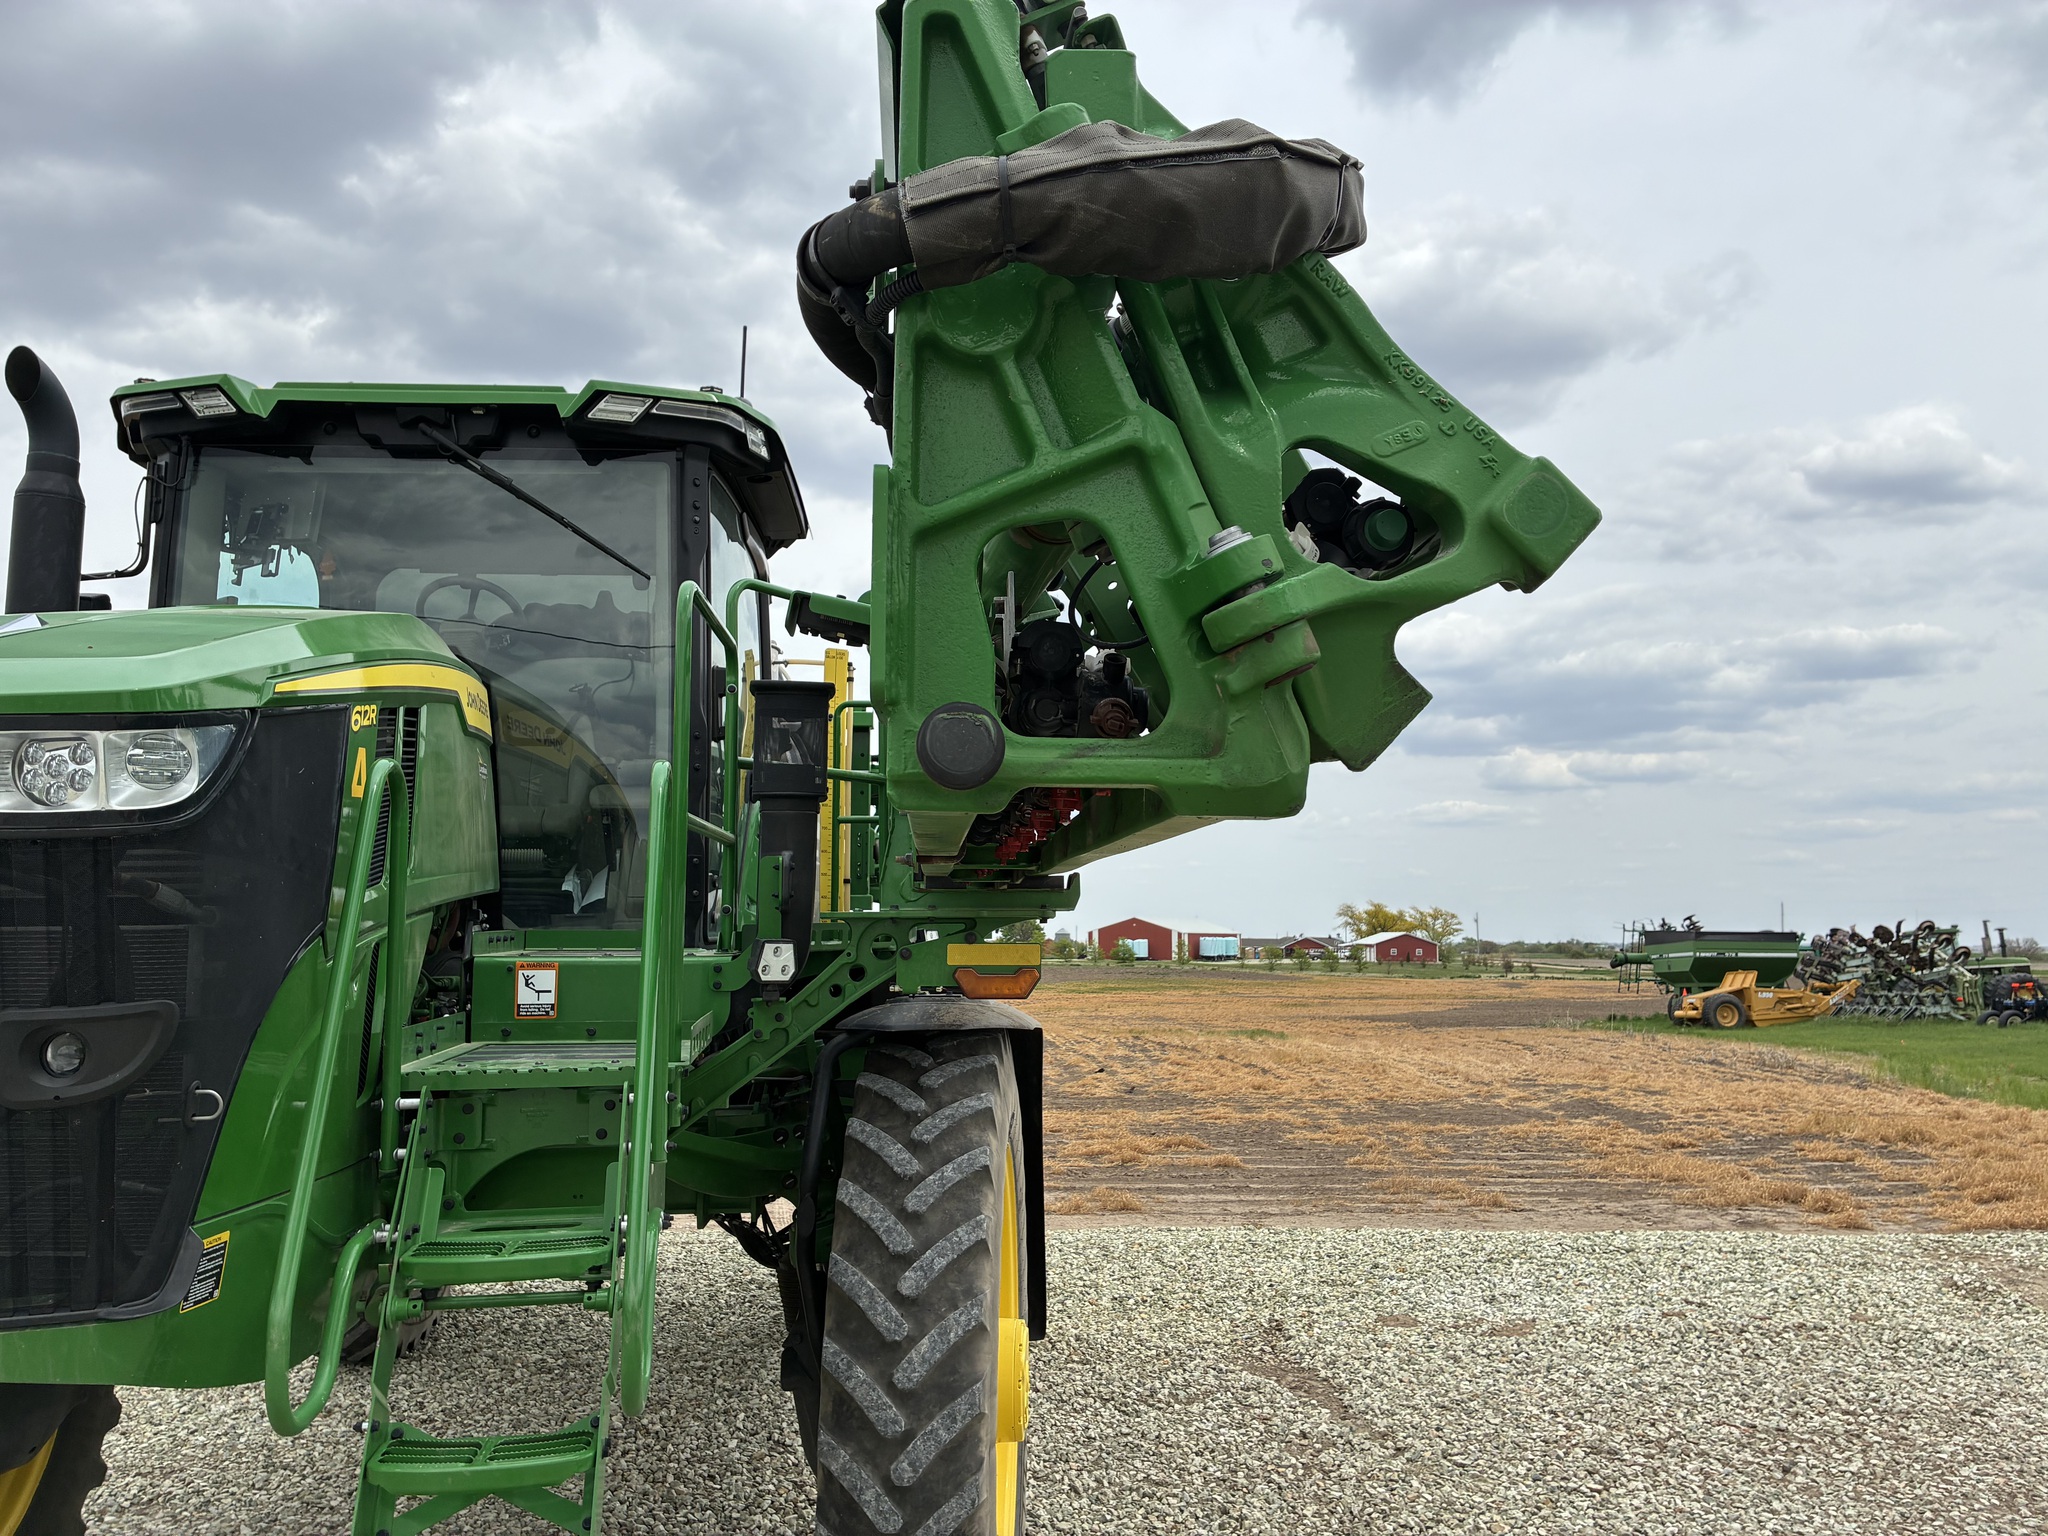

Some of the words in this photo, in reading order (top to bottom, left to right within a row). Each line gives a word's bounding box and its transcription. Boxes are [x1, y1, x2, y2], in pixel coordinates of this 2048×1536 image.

[1310, 260, 1351, 298] RAW
[1463, 416, 1497, 452] USA
[351, 704, 377, 732] 612R
[477, 692, 489, 719] DEERE
[206, 1237, 222, 1246] CAUTION
